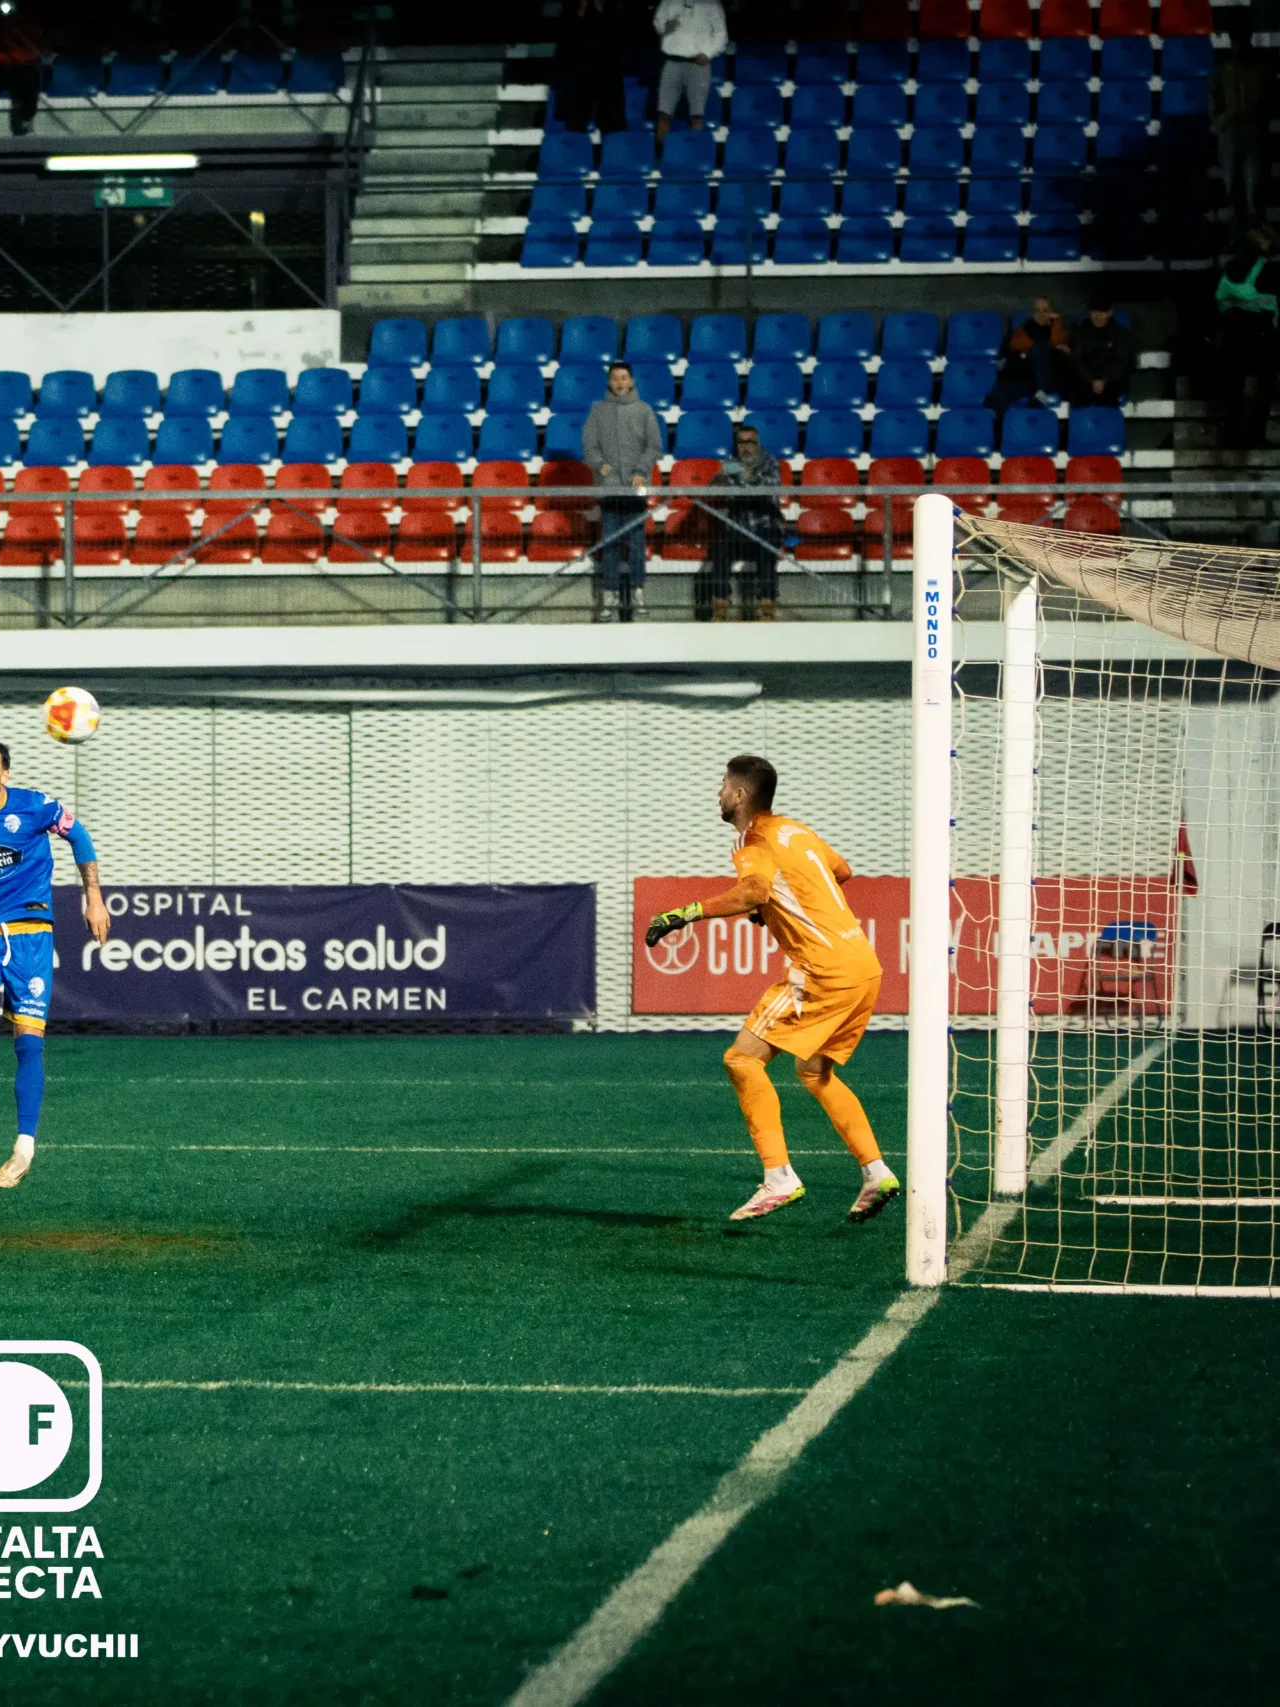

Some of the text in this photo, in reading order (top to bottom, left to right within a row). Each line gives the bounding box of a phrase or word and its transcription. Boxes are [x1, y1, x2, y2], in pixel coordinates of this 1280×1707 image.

[925, 591, 939, 659] MONDO
[805, 849, 845, 911] 1
[83, 925, 446, 971] recoletas salud
[708, 918, 795, 975] COP
[248, 988, 447, 1010] EL CARMEN
